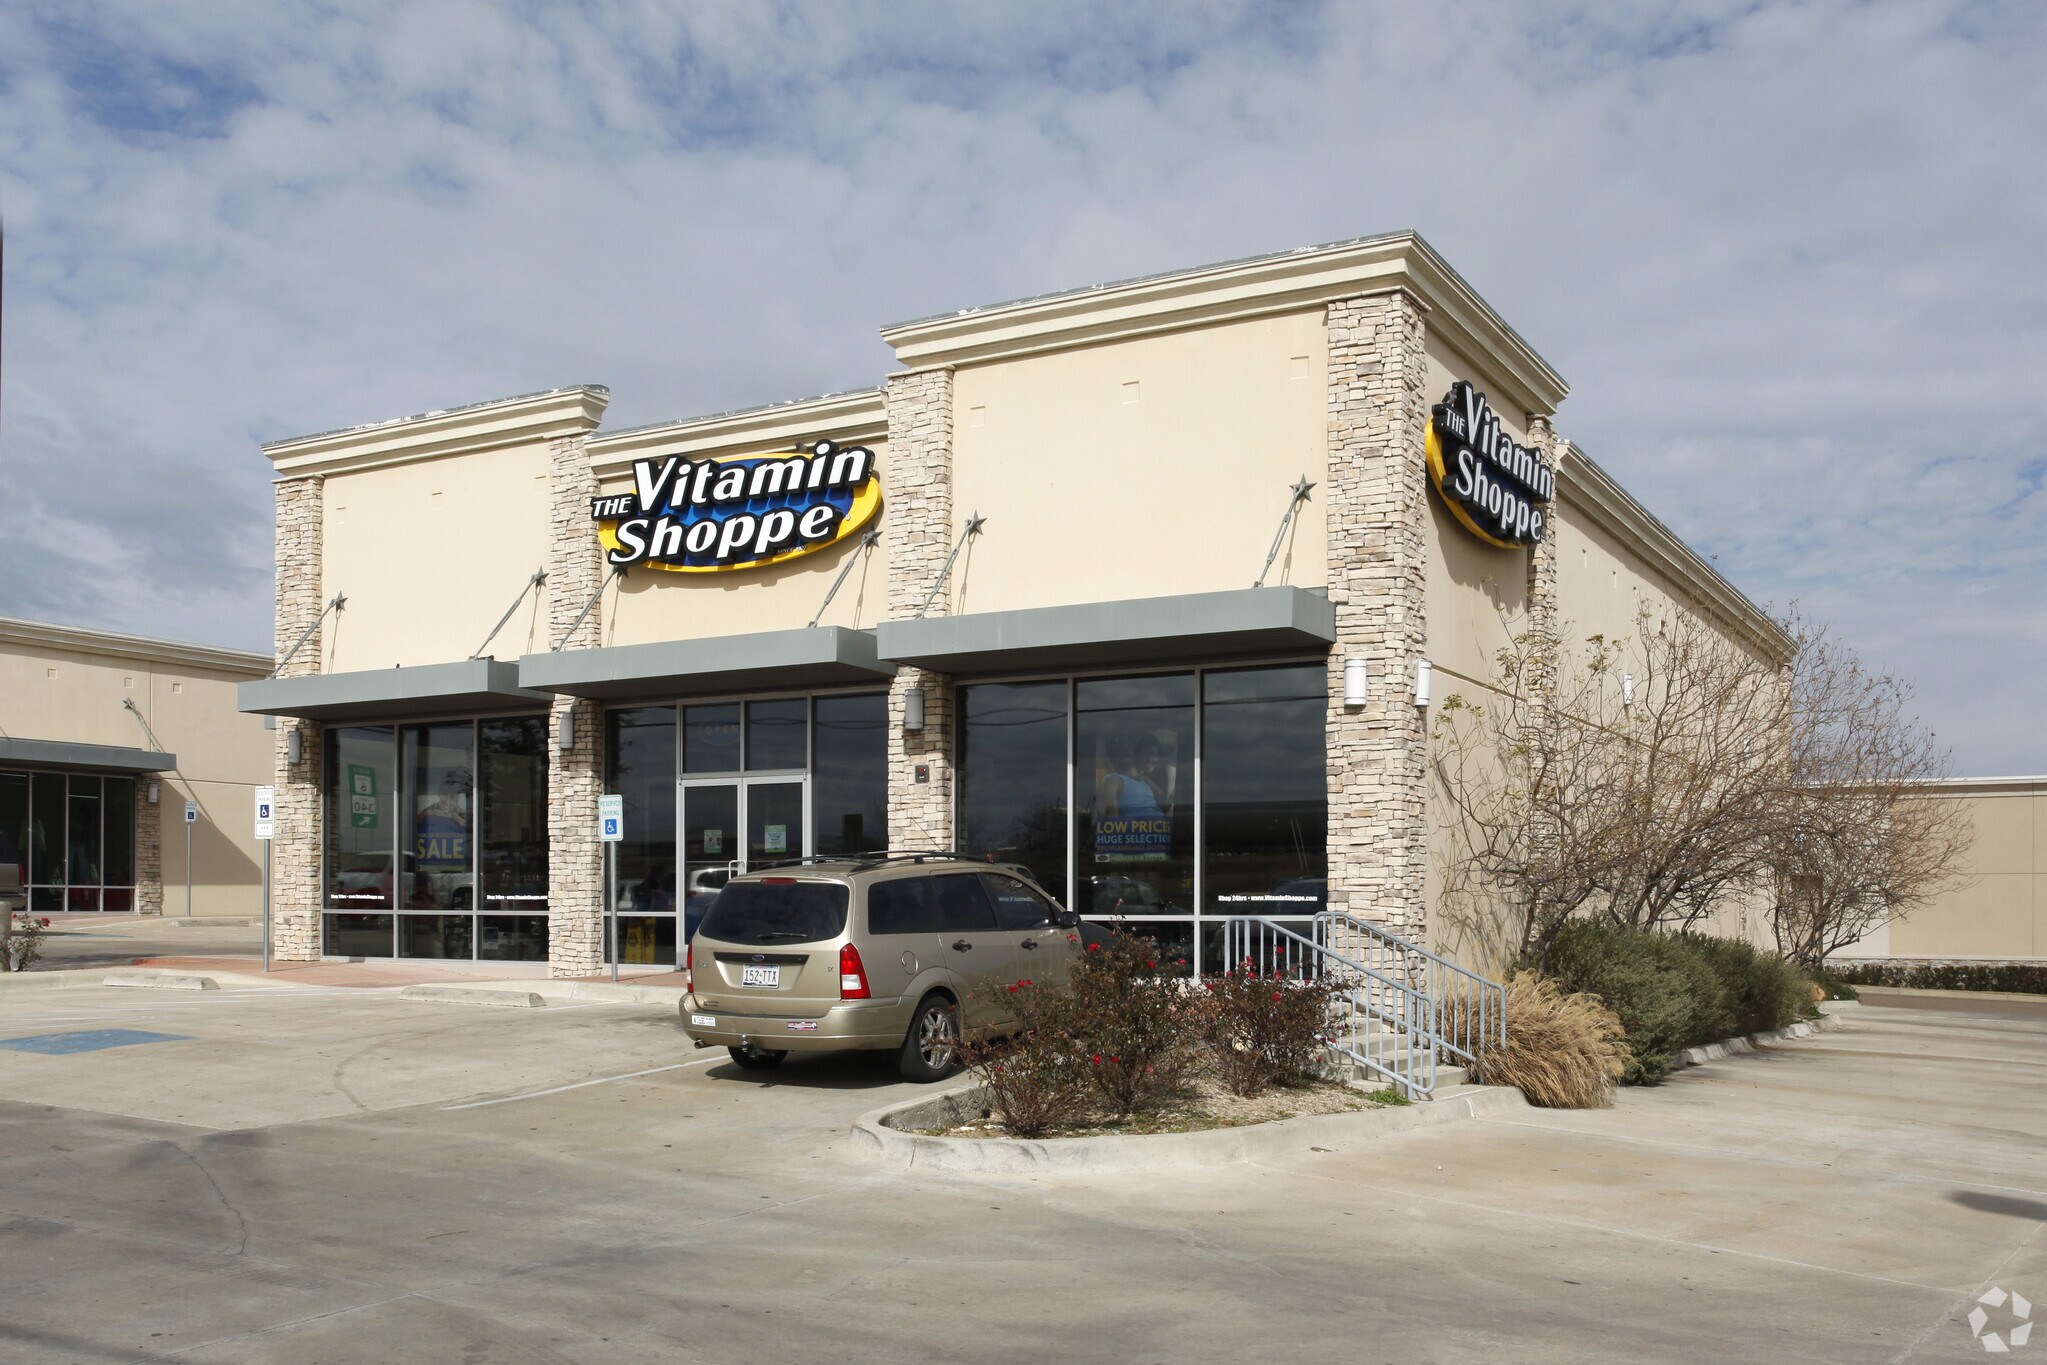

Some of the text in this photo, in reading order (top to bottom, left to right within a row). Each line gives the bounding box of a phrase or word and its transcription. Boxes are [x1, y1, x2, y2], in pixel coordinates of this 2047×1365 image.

[1446, 408, 1466, 436] THE
[1466, 386, 1552, 498] Vitamin
[634, 442, 867, 512] Vitamin
[593, 497, 632, 517] THE
[1456, 450, 1542, 540] Shoppe
[610, 505, 834, 563] Shoppe
[1097, 821, 1128, 834] LOW
[1097, 834, 1124, 844] HUGE
[417, 838, 464, 860] SALE
[744, 969, 777, 982] 152 TTX
